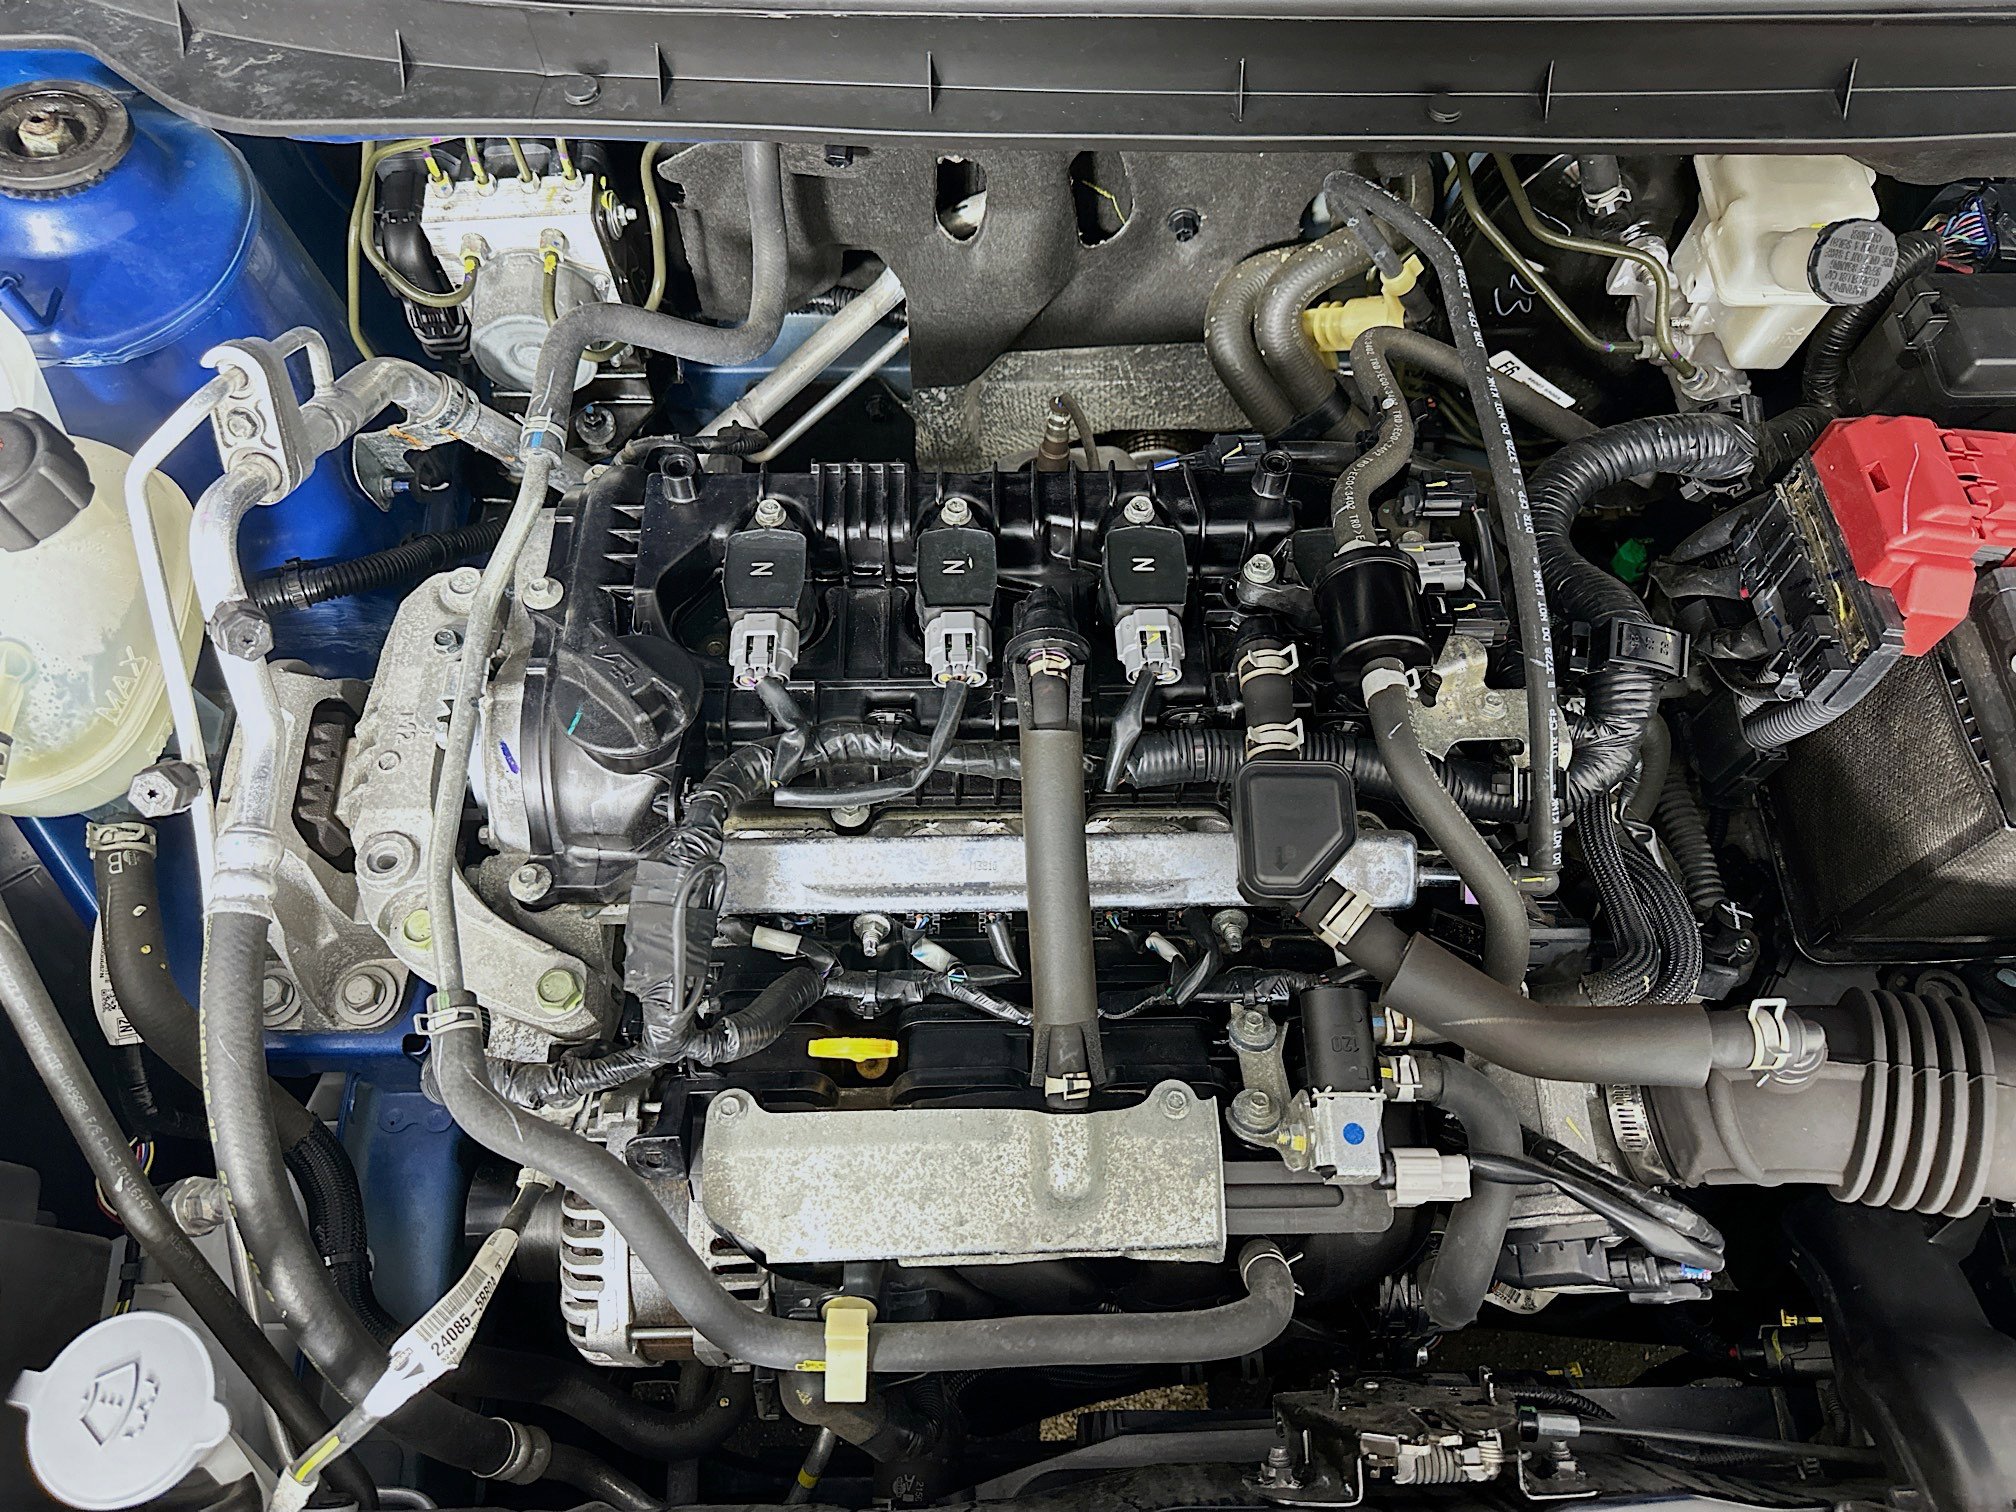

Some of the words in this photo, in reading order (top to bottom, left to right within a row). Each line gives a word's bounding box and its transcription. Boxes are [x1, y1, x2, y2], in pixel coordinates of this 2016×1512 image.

[1494, 401, 1506, 419] NOT
[1500, 422, 1510, 435] DO
[1523, 513, 1534, 534] DTR
[1537, 601, 1548, 622] NOT
[1541, 626, 1551, 642] DO
[1551, 829, 1562, 849] NOT
[108, 851, 123, 875] B
[1552, 852, 1562, 865] DO
[1331, 1036, 1360, 1053] 120
